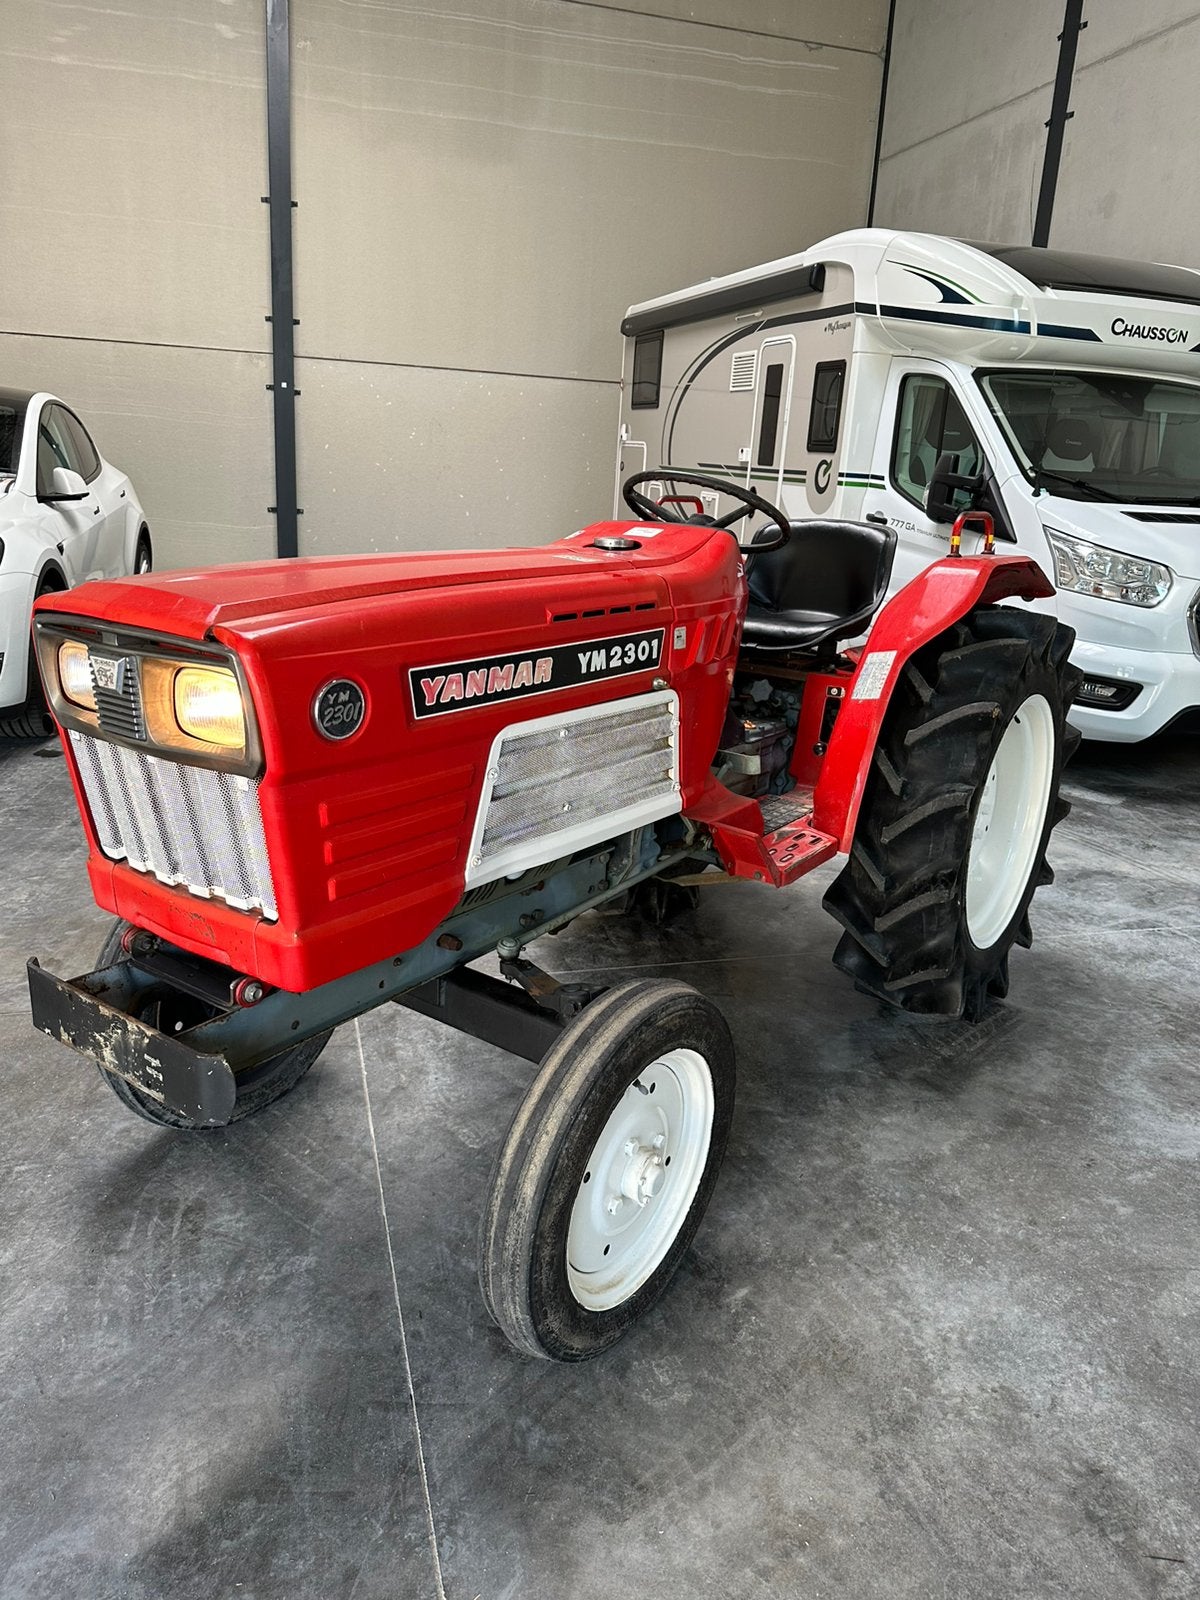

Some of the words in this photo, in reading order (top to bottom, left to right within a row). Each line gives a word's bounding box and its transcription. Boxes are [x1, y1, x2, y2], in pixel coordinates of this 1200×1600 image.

[1111, 317, 1188, 343] CHAUSSON
[890, 518, 905, 528] 777
[905, 522, 916, 532] GA
[421, 657, 552, 706] YANMAR
[578, 638, 658, 674] YM2301
[327, 690, 350, 705] YM
[323, 701, 361, 727] 2301
